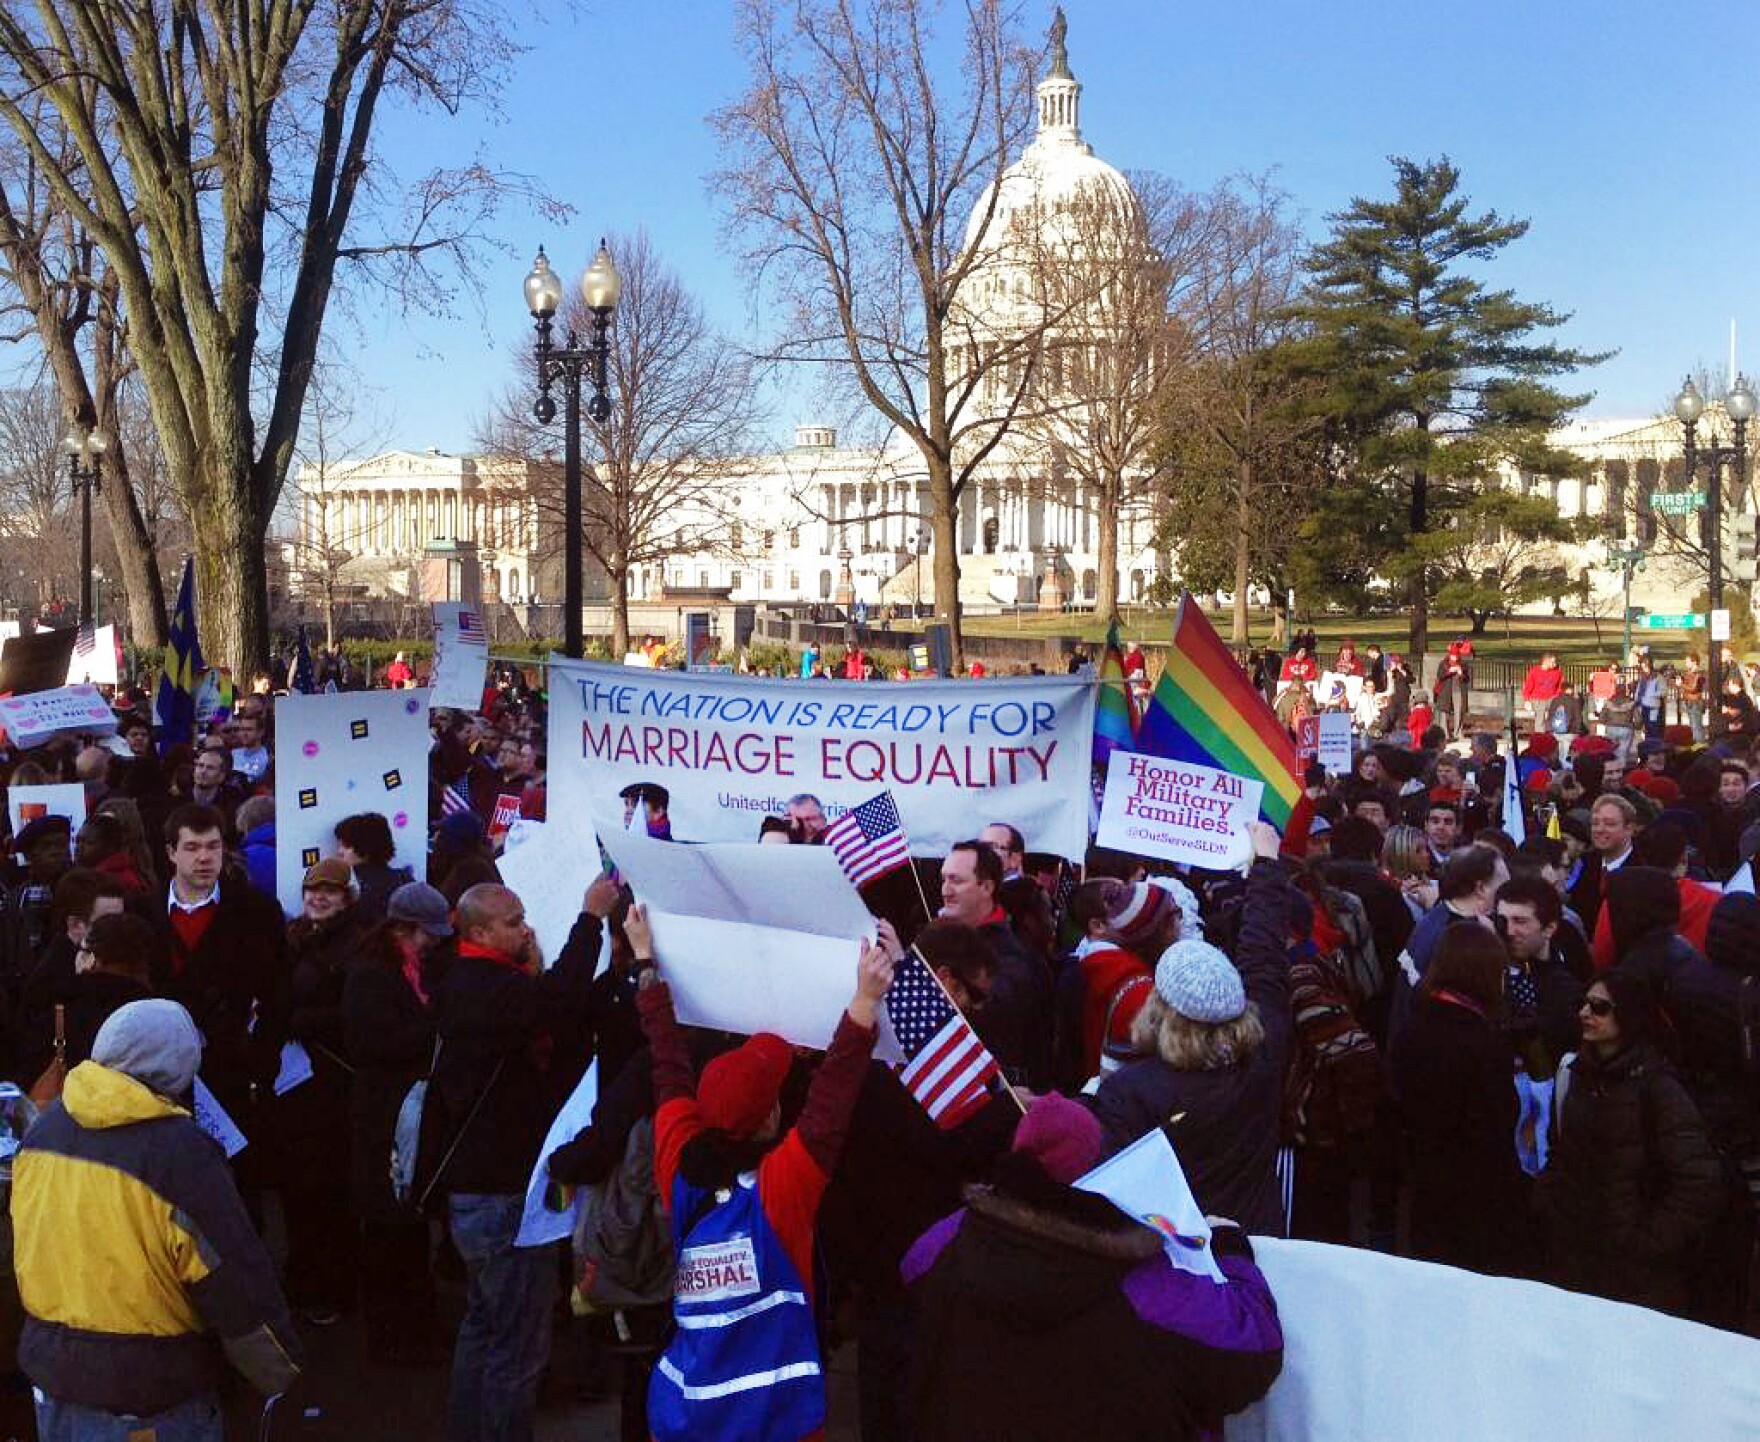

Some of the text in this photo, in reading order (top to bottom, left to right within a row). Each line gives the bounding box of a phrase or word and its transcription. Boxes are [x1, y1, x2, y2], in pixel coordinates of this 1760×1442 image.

[1651, 494, 1692, 506] FIRST
[577, 678, 1056, 737] THE NATION IS READY FOR
[581, 720, 1058, 788] MARRIAGE EQUALITY
[1127, 757, 1243, 799] Honor All
[1136, 777, 1234, 820] Military
[1125, 795, 1235, 837] Families.
[1127, 826, 1228, 855] @OutServeSLDN
